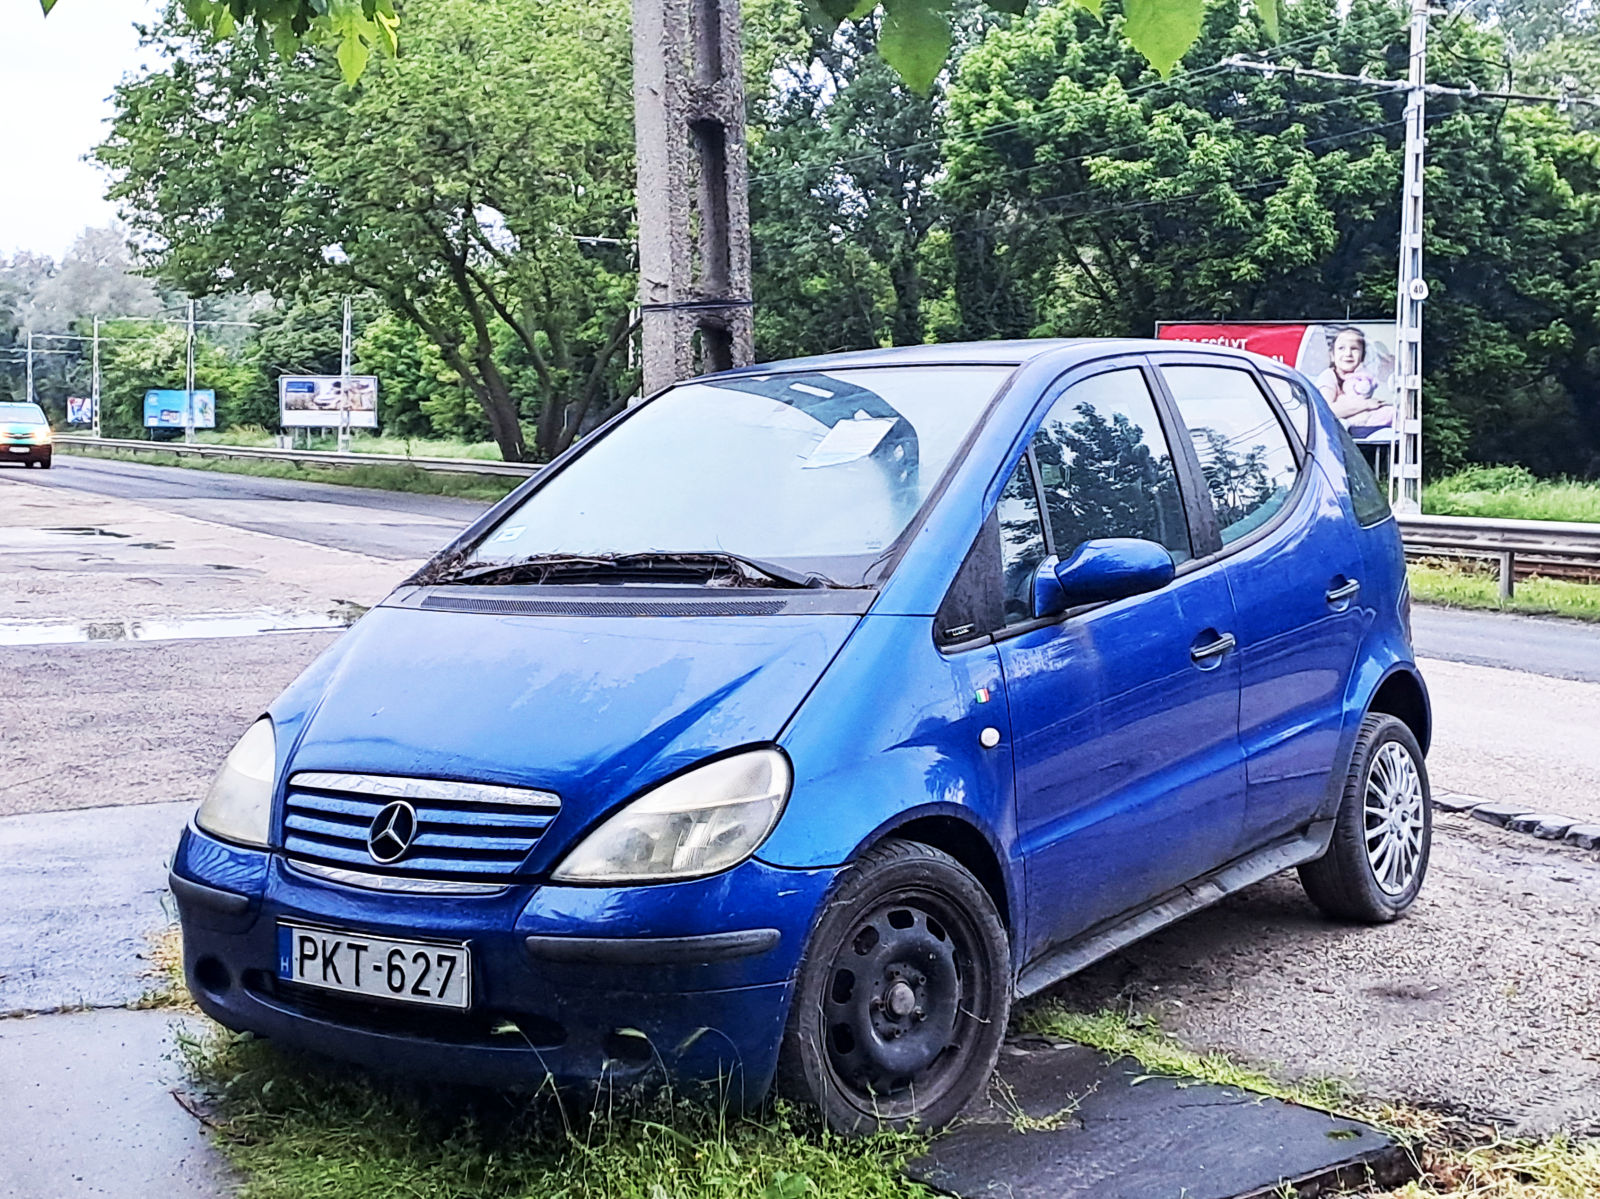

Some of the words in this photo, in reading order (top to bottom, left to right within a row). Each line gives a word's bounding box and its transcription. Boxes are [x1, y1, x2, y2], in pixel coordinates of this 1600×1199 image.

[1413, 285, 1424, 294] 40
[280, 957, 289, 972] H
[298, 935, 457, 998] PKT-627
